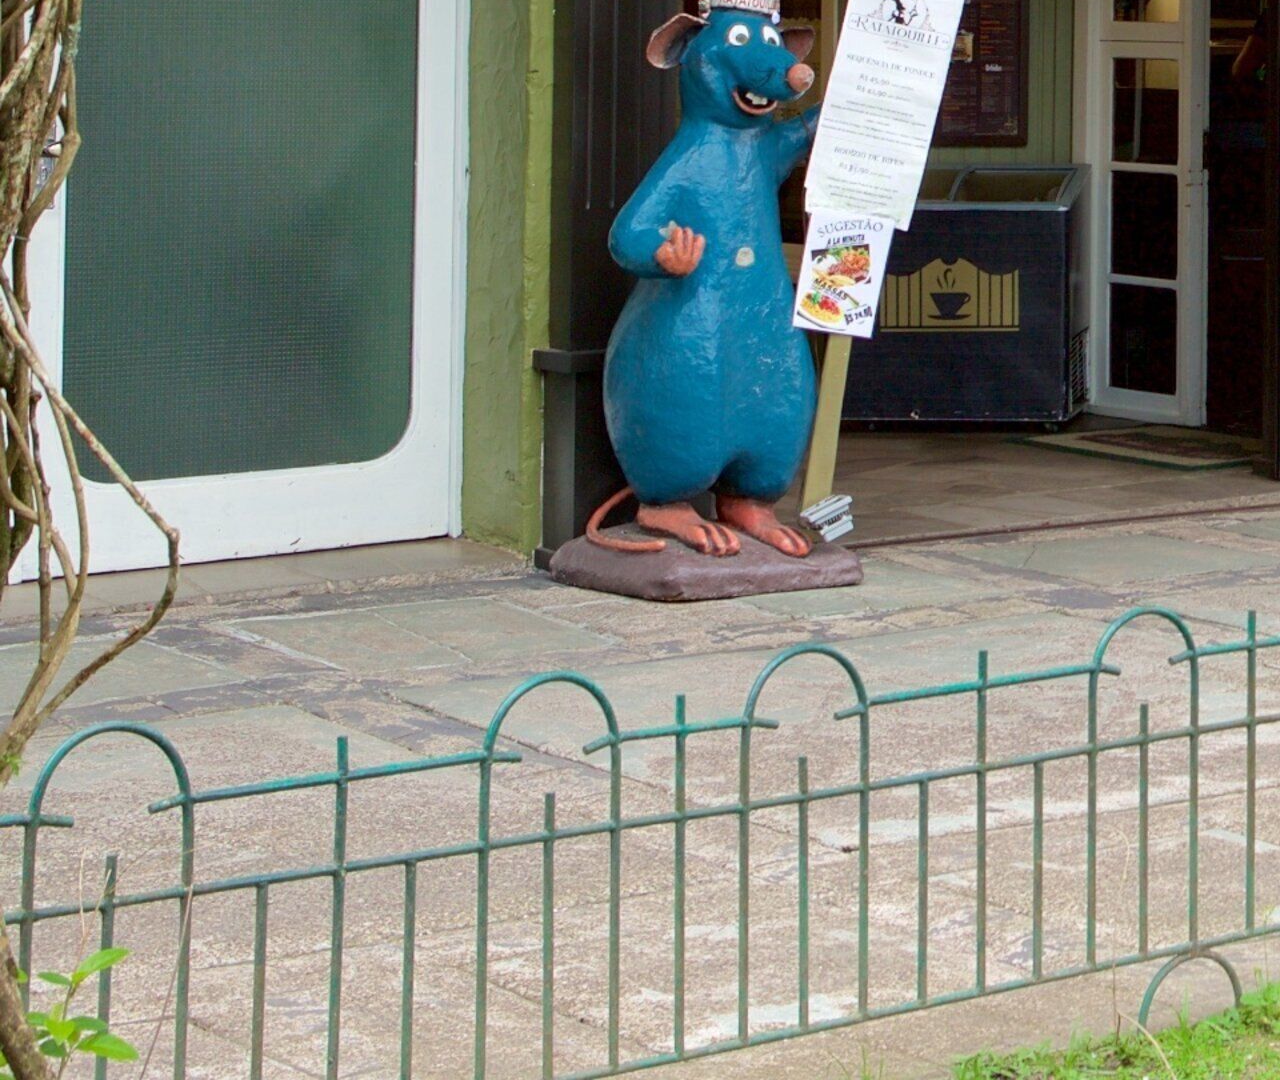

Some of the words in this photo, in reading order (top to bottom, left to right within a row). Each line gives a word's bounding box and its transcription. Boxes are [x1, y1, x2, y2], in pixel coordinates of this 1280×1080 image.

[816, 218, 884, 238] SUGESTÃO
[832, 237, 841, 245] LA
[842, 234, 866, 245] MINUTA
[813, 277, 849, 302] MASSAS
